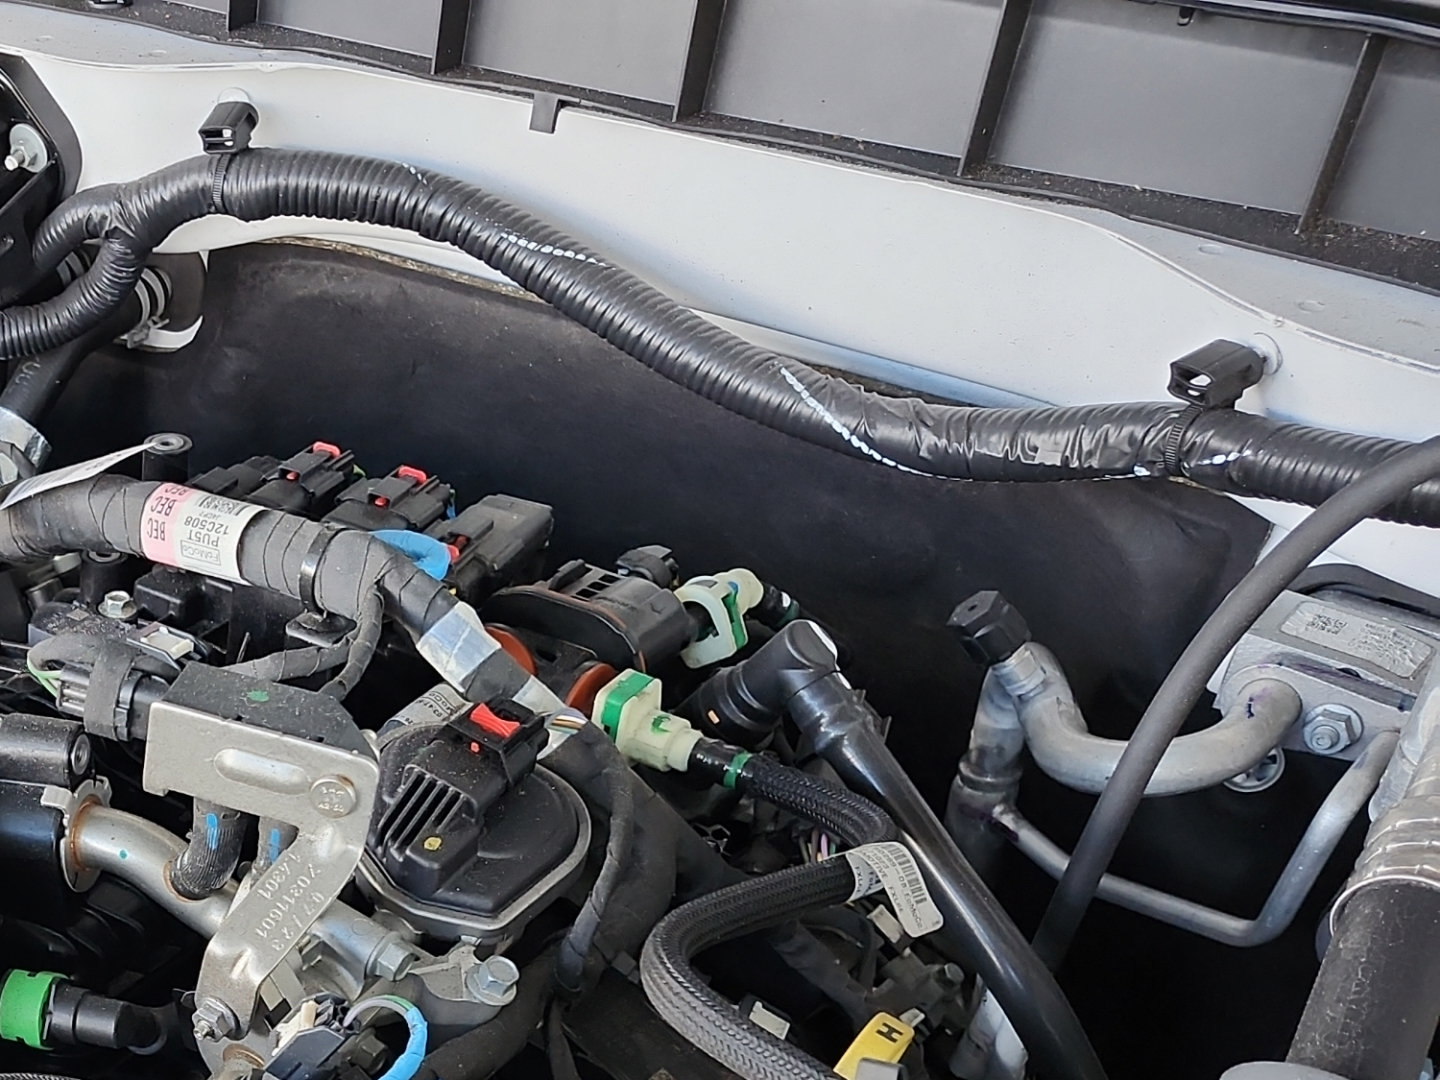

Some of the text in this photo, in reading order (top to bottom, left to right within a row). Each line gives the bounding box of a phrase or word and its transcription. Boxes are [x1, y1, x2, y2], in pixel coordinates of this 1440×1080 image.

[150, 496, 177, 516] BEC
[146, 517, 166, 542] BEC
[184, 515, 230, 536] 12C508
[187, 529, 220, 548] PU5T
[875, 1022, 904, 1044] H
